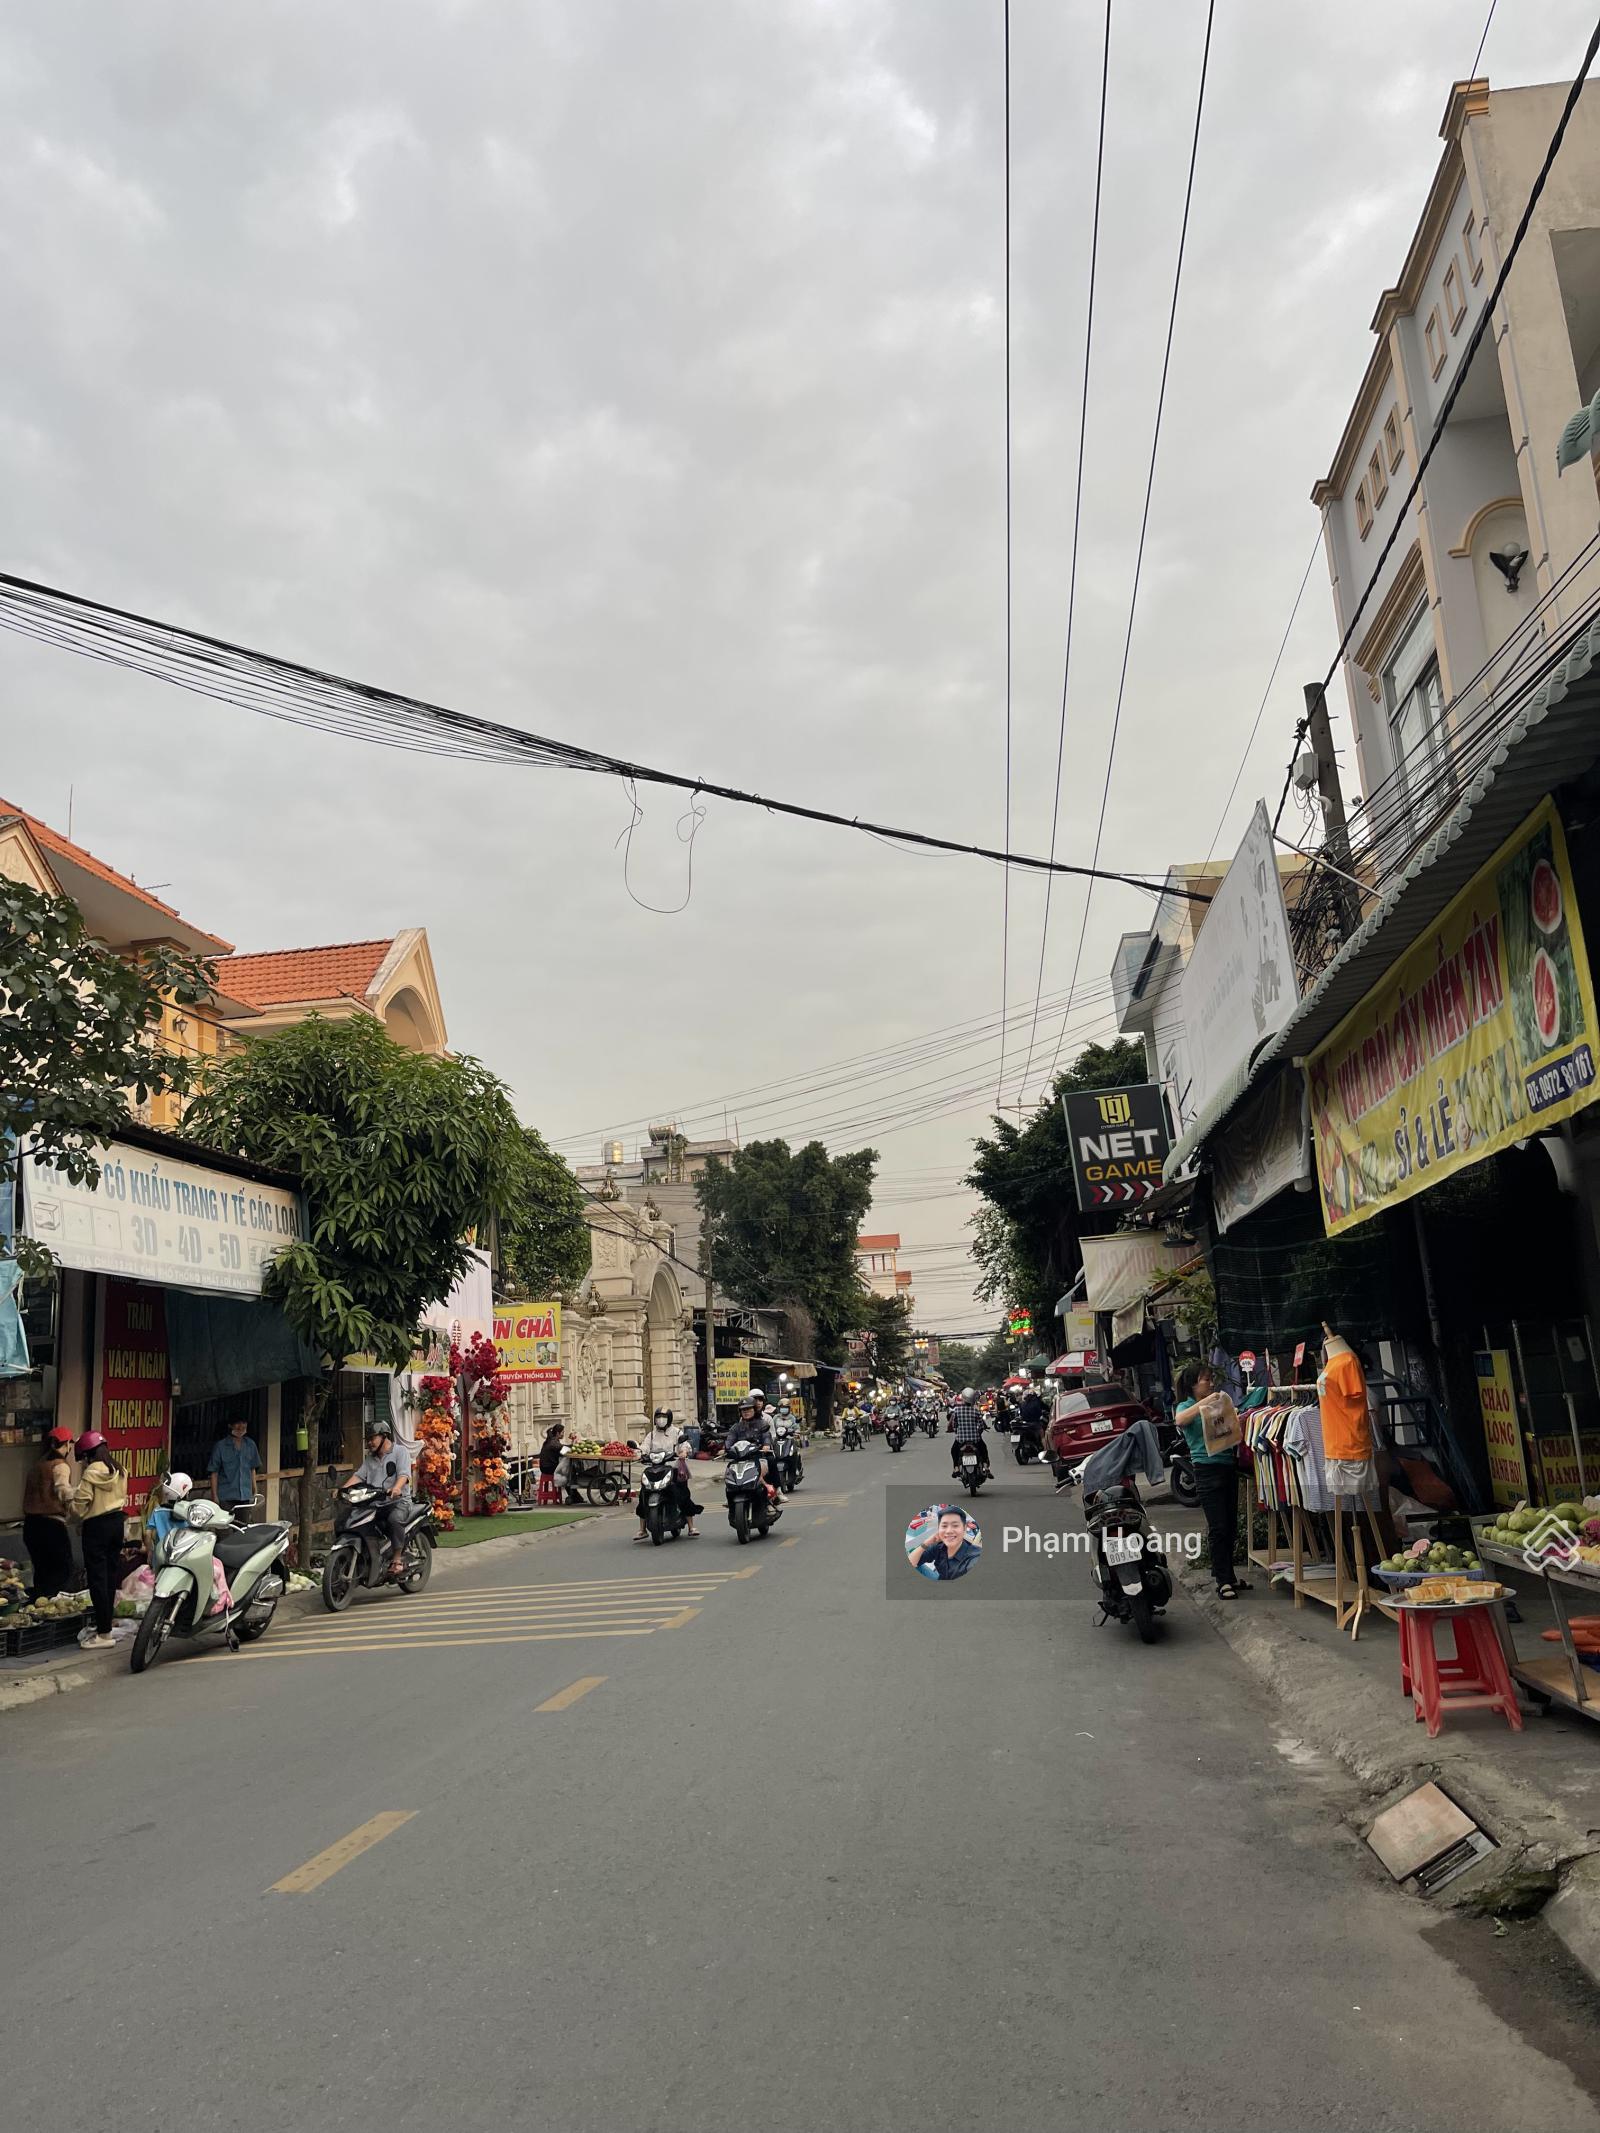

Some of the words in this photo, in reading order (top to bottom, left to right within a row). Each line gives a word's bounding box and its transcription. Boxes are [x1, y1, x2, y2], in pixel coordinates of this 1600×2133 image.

[1539, 1069, 1565, 1100] 0972
[1079, 1129, 1158, 1162] NET
[1395, 1107, 1412, 1180] SỈ
[1416, 1116, 1430, 1169] &
[1430, 1079, 1455, 1159] LẺ
[1086, 1159, 1163, 1180] GAME
[104, 1159, 126, 1201] CÓ
[130, 1163, 170, 1212] KHẨU
[173, 1181, 218, 1221] TRANG
[221, 1191, 228, 1223] Y
[231, 1187, 247, 1226] TẾ
[249, 1194, 272, 1232] CÁC
[275, 1204, 301, 1242] LOẠI
[131, 1215, 158, 1256] 3D
[178, 1225, 202, 1263] 4D
[219, 1233, 241, 1269] 5D
[516, 1309, 554, 1338] CHẢ
[108, 1345, 136, 1378] VÁCH
[108, 1400, 141, 1435] THẠCH
[144, 1400, 163, 1427] CAO
[136, 1446, 162, 1478] NAN
